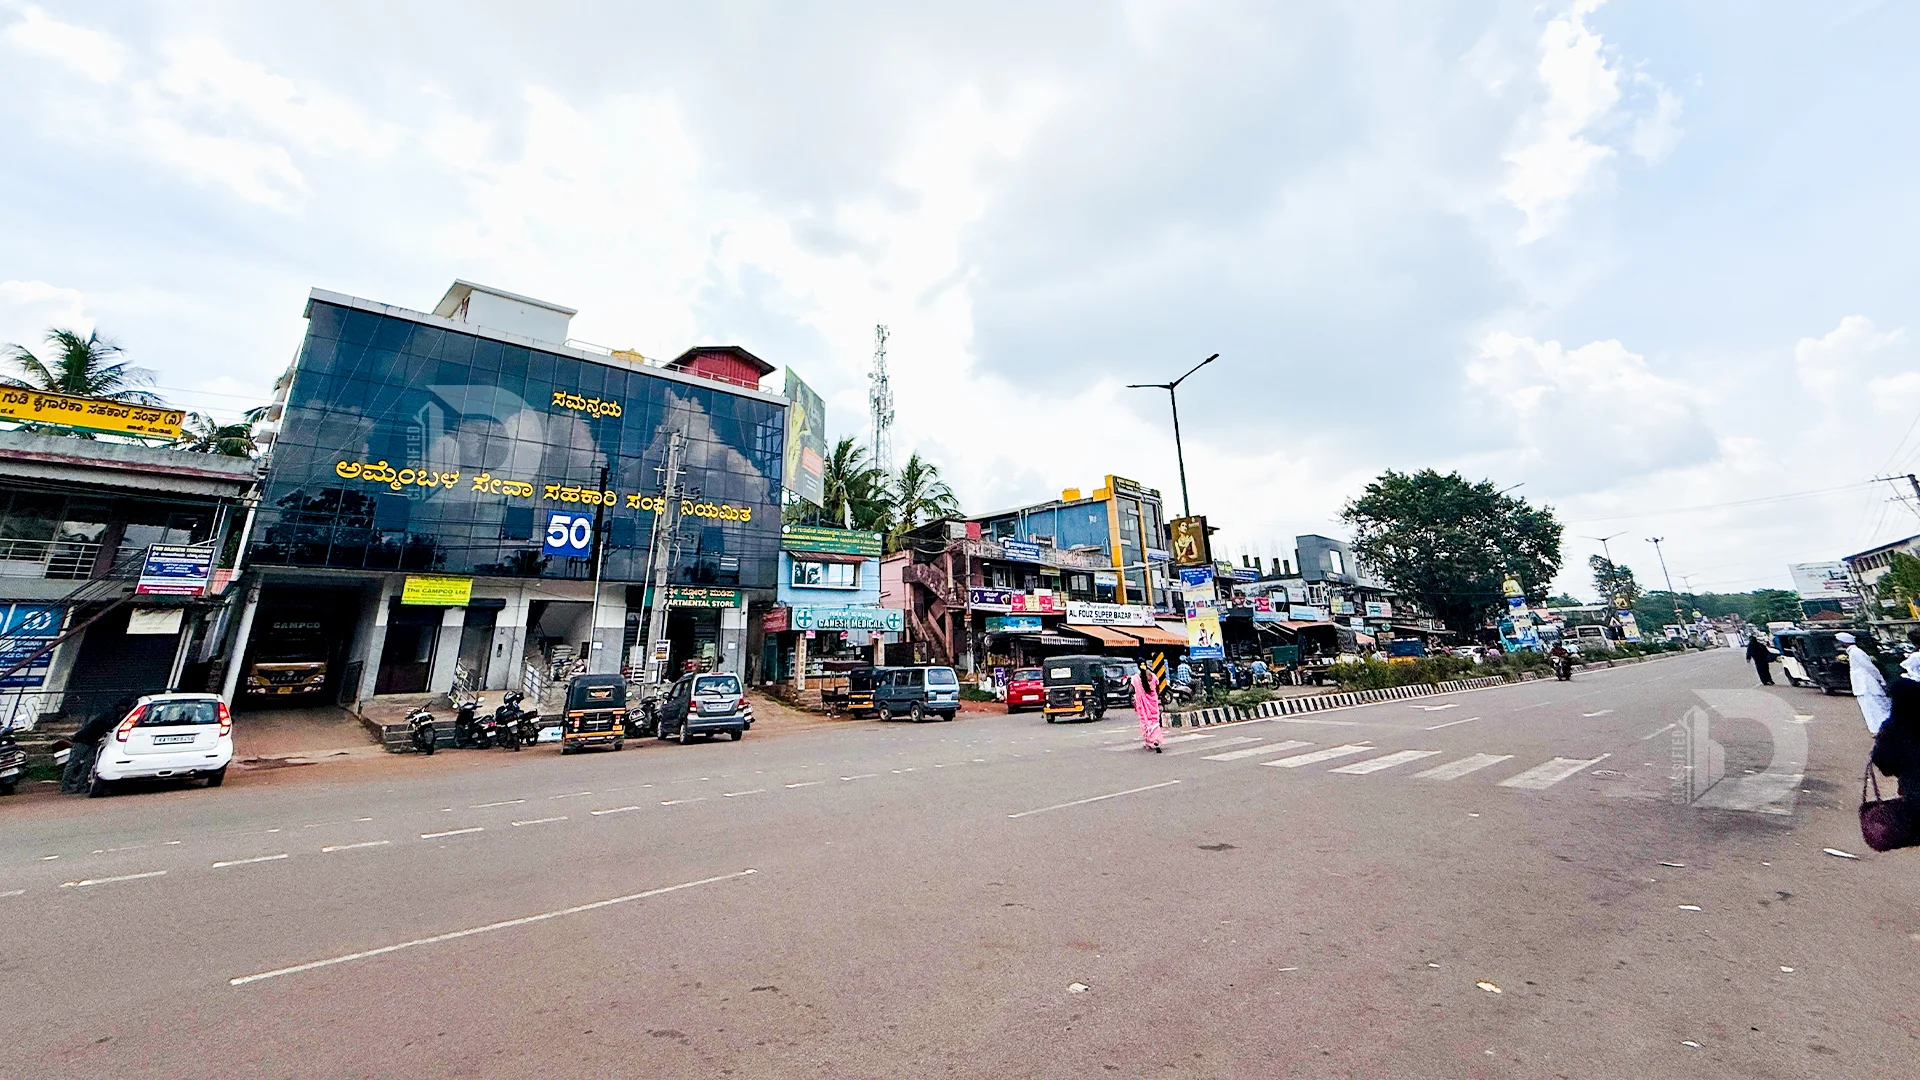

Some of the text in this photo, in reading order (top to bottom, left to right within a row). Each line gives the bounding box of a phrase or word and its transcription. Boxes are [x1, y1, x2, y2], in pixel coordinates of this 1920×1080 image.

[86, 404, 130, 418] ಸಹಕಾರ
[132, 410, 161, 424] ಸಂಘ
[164, 412, 182, 426] (ನಿ)
[552, 390, 622, 418] ಸಮನ್ವಯ
[335, 459, 460, 491] ಅಮ್ಮೆಂಬಳ
[471, 471, 535, 499] ಸೇವಾ
[542, 482, 618, 508] ಸಹಕಾರಿ
[547, 514, 592, 549] 50
[663, 599, 710, 607] PARTMENTAL
[818, 619, 886, 630] GANESH MEDICALS
